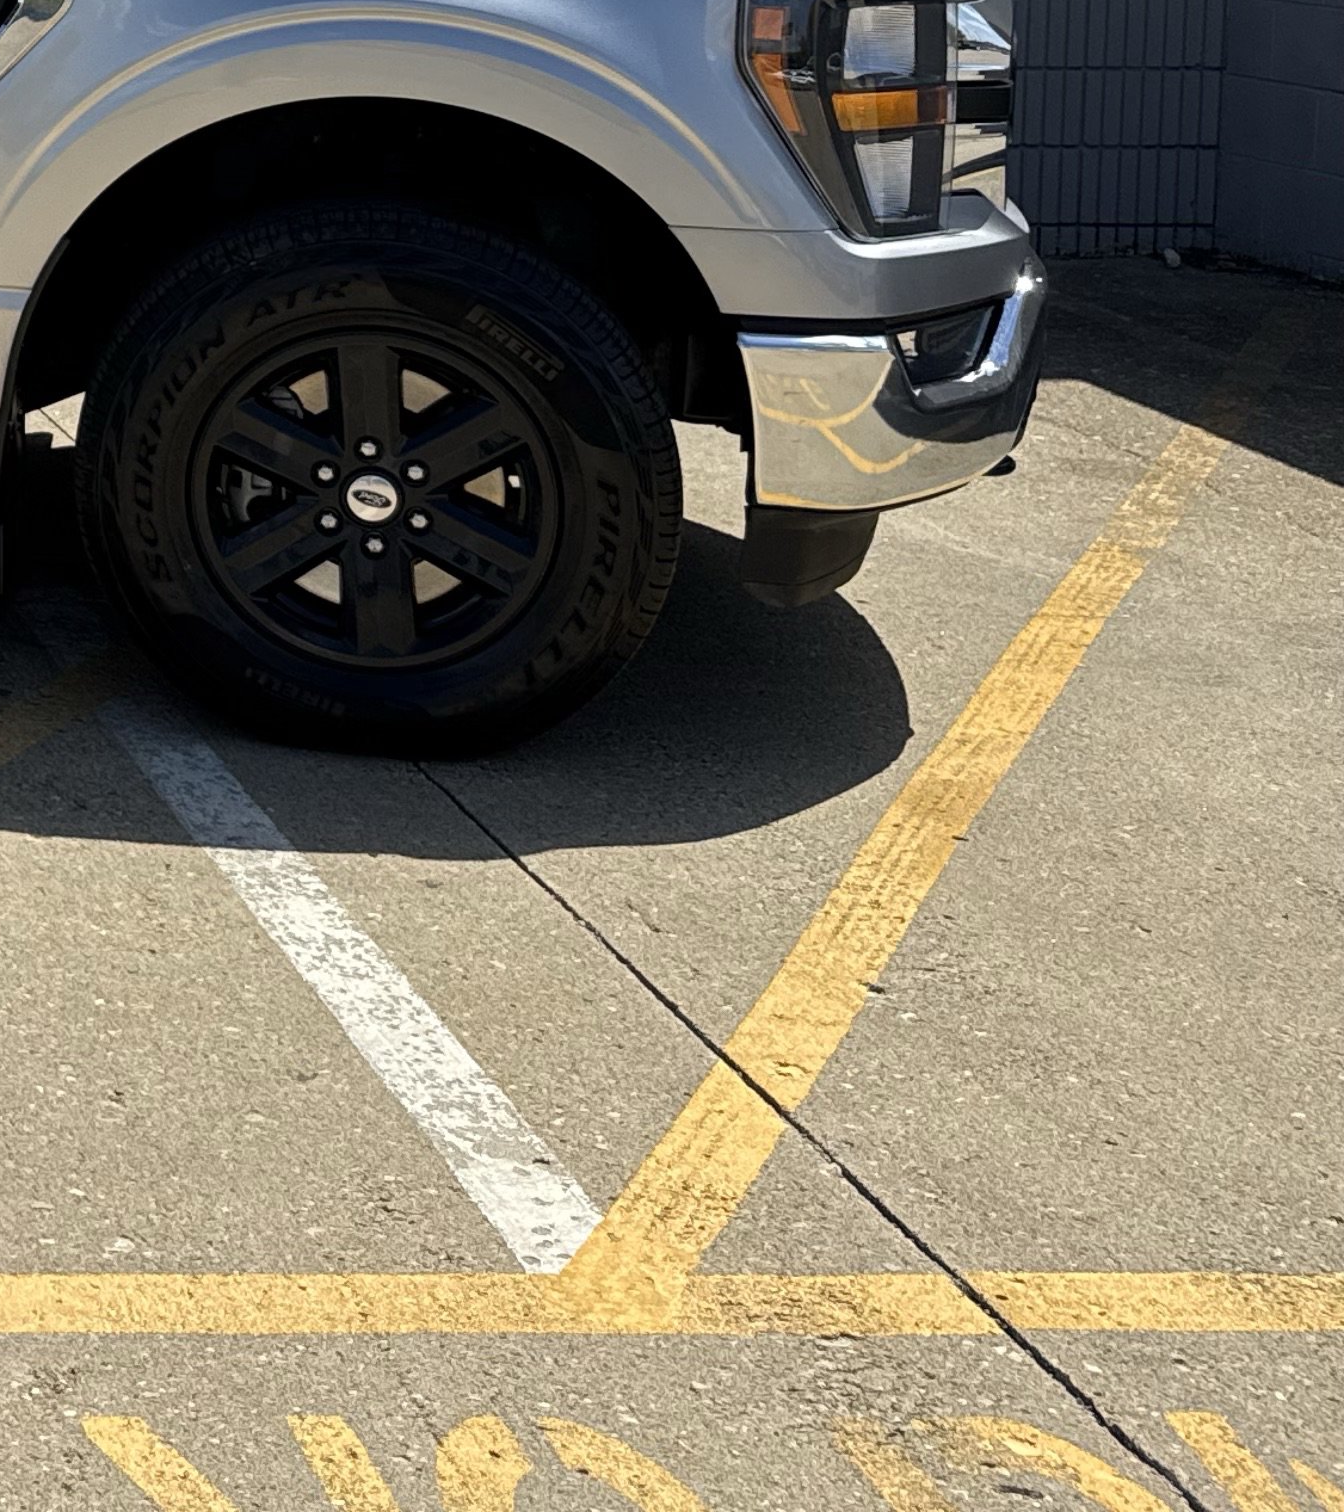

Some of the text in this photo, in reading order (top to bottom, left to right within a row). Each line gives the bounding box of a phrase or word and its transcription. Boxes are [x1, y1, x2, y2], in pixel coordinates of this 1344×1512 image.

[133, 279, 352, 583] SCORPION ATR
[465, 304, 565, 382] PIRELLI
[525, 478, 622, 687] PIRELLI
